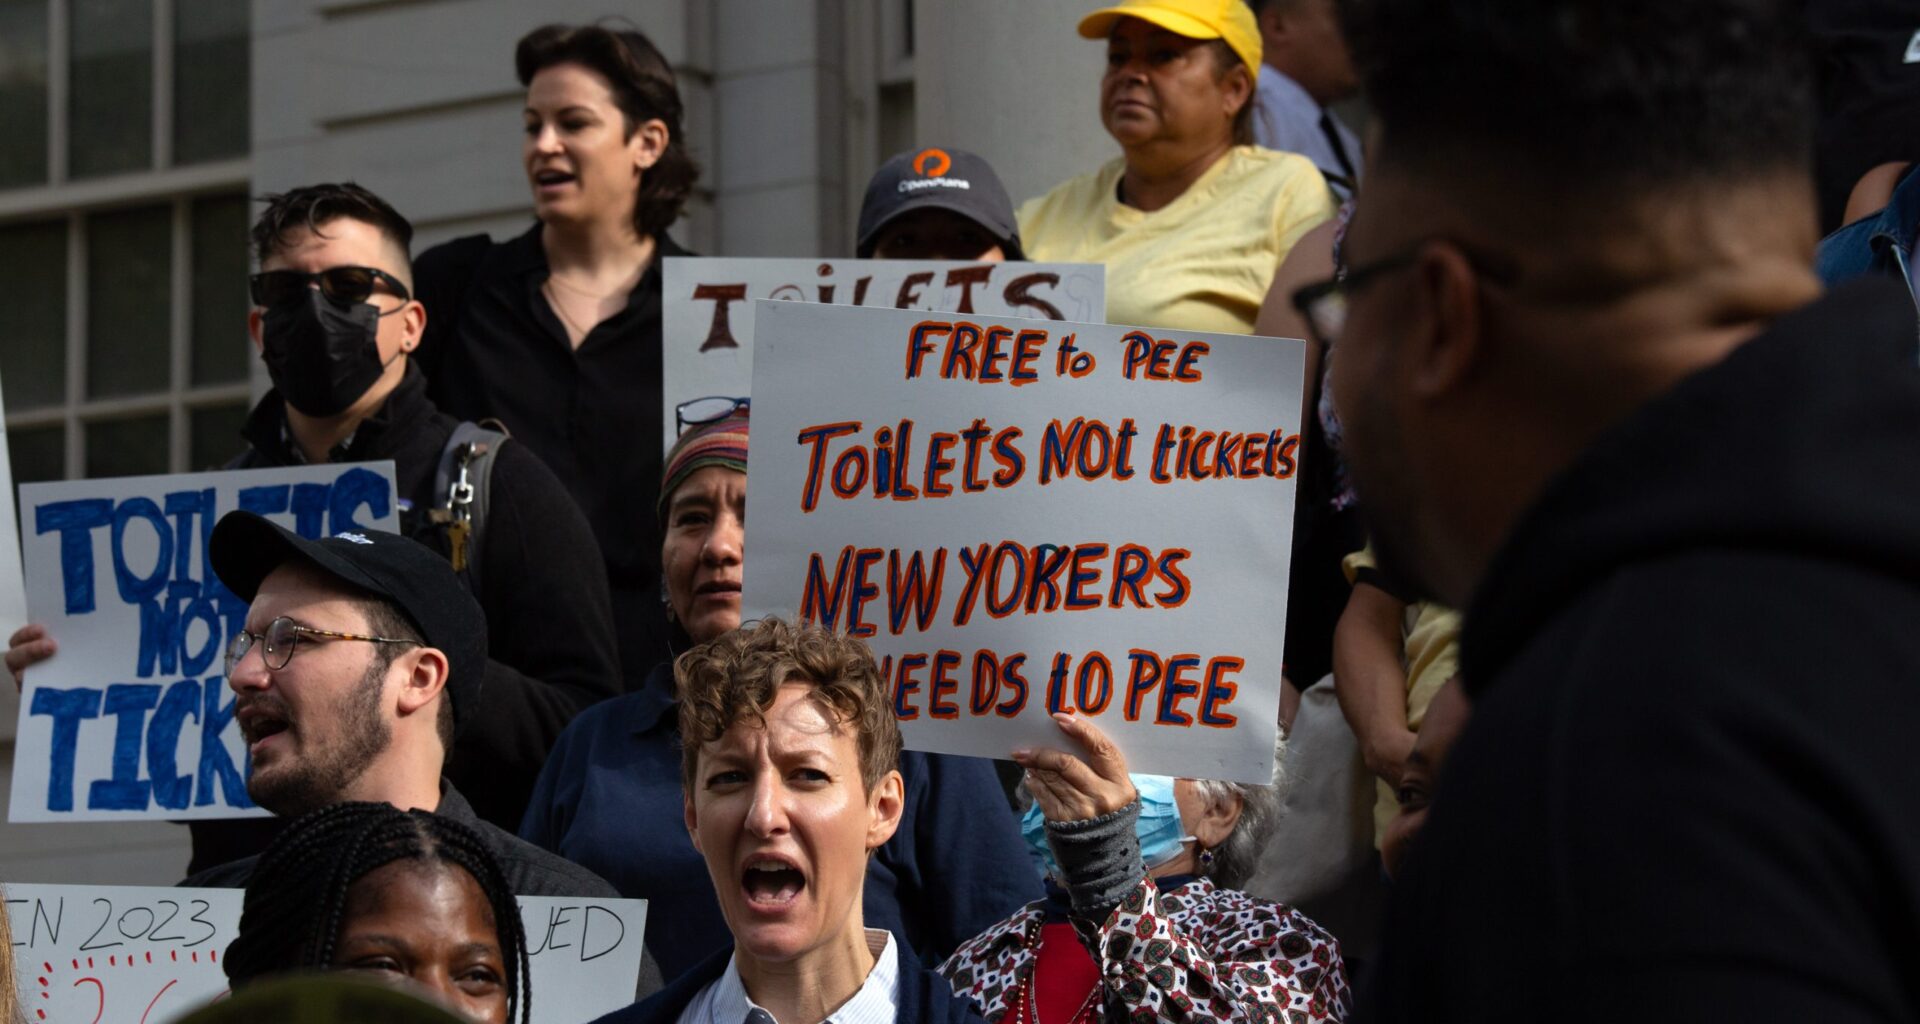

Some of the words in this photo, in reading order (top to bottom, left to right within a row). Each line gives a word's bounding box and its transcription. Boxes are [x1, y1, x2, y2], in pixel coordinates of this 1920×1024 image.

[905, 320, 1048, 386] FREE
[1056, 333, 1096, 378] to
[1121, 330, 1210, 382] PEE
[802, 545, 948, 639] NEW
[1122, 648, 1245, 728] PEE
[30, 680, 255, 812] TICK
[79, 898, 216, 950] 2023
